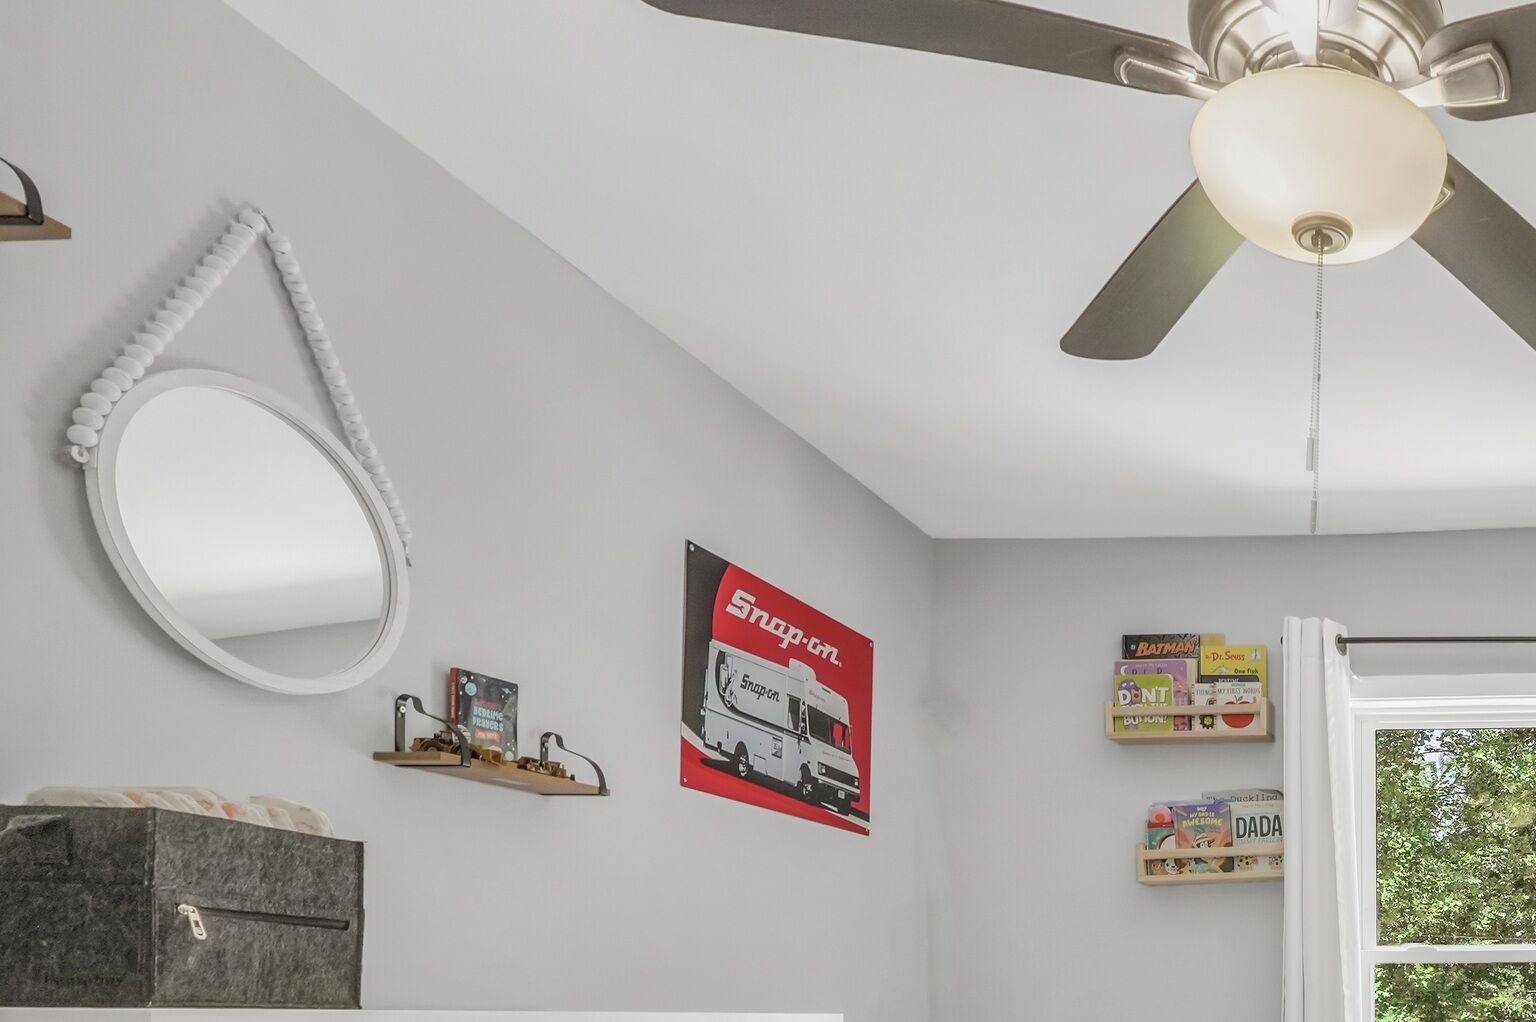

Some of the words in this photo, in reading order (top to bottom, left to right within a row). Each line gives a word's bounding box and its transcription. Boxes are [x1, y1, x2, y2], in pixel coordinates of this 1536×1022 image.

[1135, 641, 1195, 656] BATMAN
[1211, 652, 1224, 661] Dr.
[1225, 651, 1245, 661] Seuss
[740, 674, 780, 702] Snap-on
[1182, 818, 1224, 828] AWESOME
[1236, 814, 1283, 839] DADA
